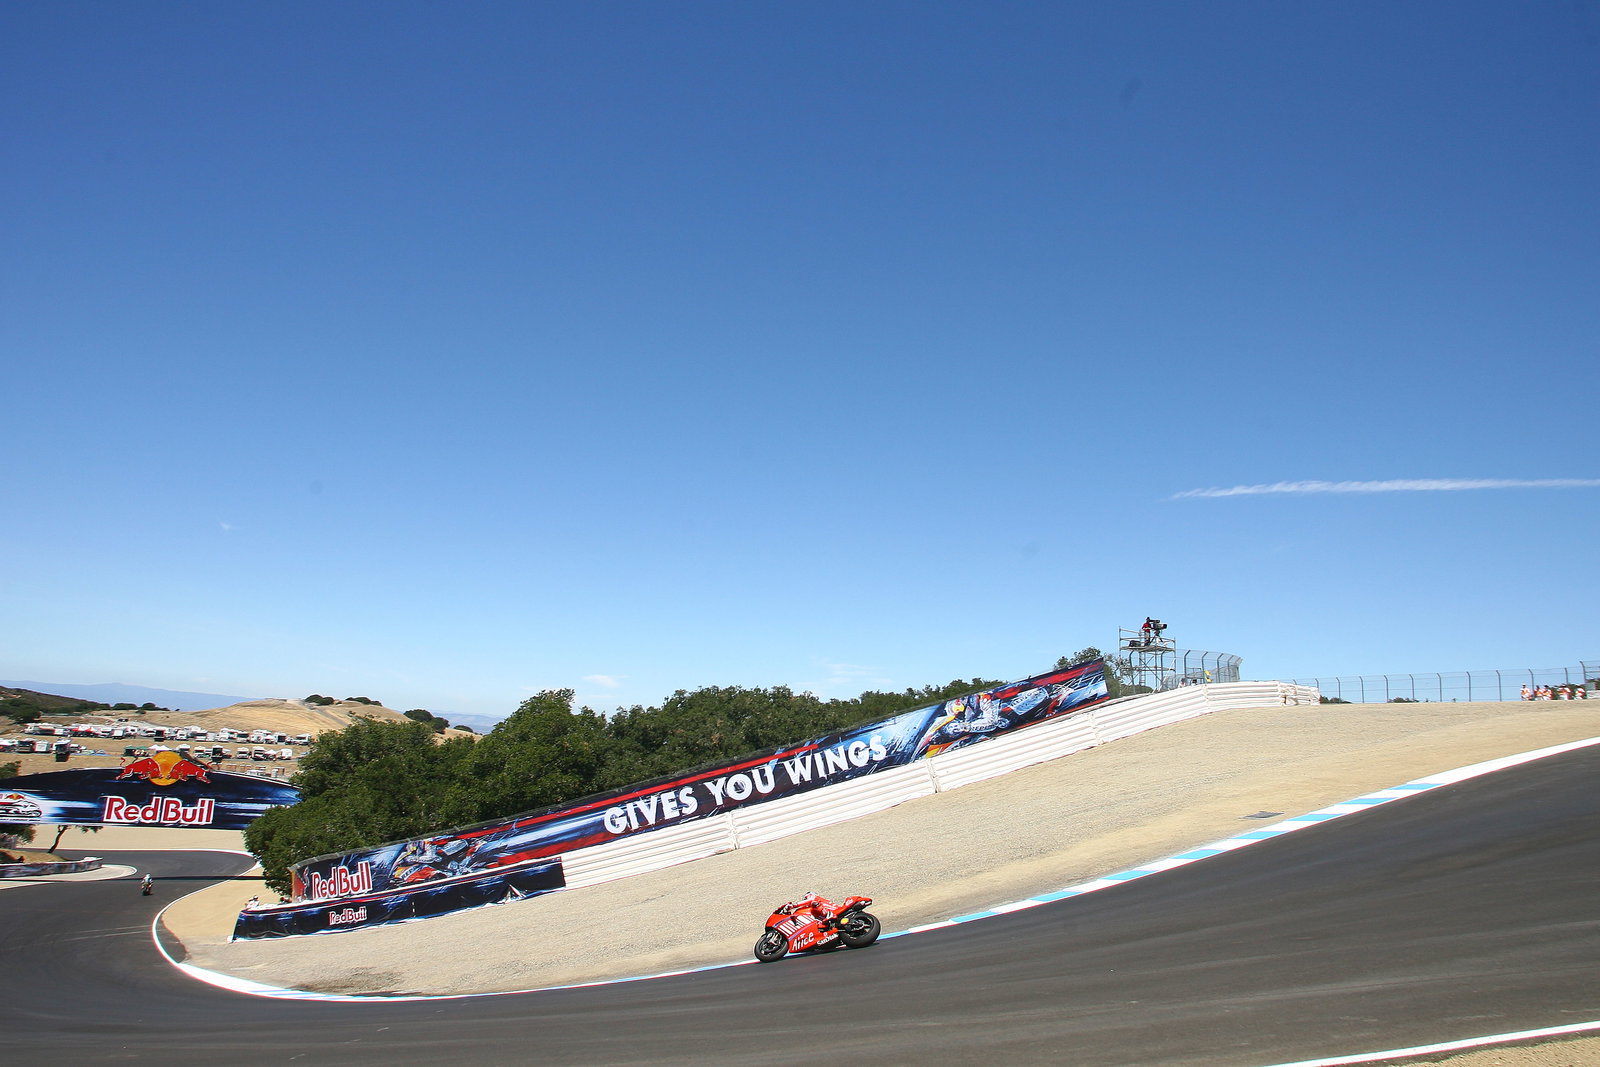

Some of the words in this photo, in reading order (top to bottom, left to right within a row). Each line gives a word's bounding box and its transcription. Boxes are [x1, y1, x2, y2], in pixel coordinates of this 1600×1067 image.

[604, 786, 698, 834] GIVES
[704, 765, 776, 806] YOU
[784, 735, 887, 786] WINGS
[103, 796, 161, 823] Red
[161, 798, 215, 825] Bull
[312, 867, 338, 899] Red
[338, 861, 373, 896] Bull
[792, 932, 815, 951] Alice
